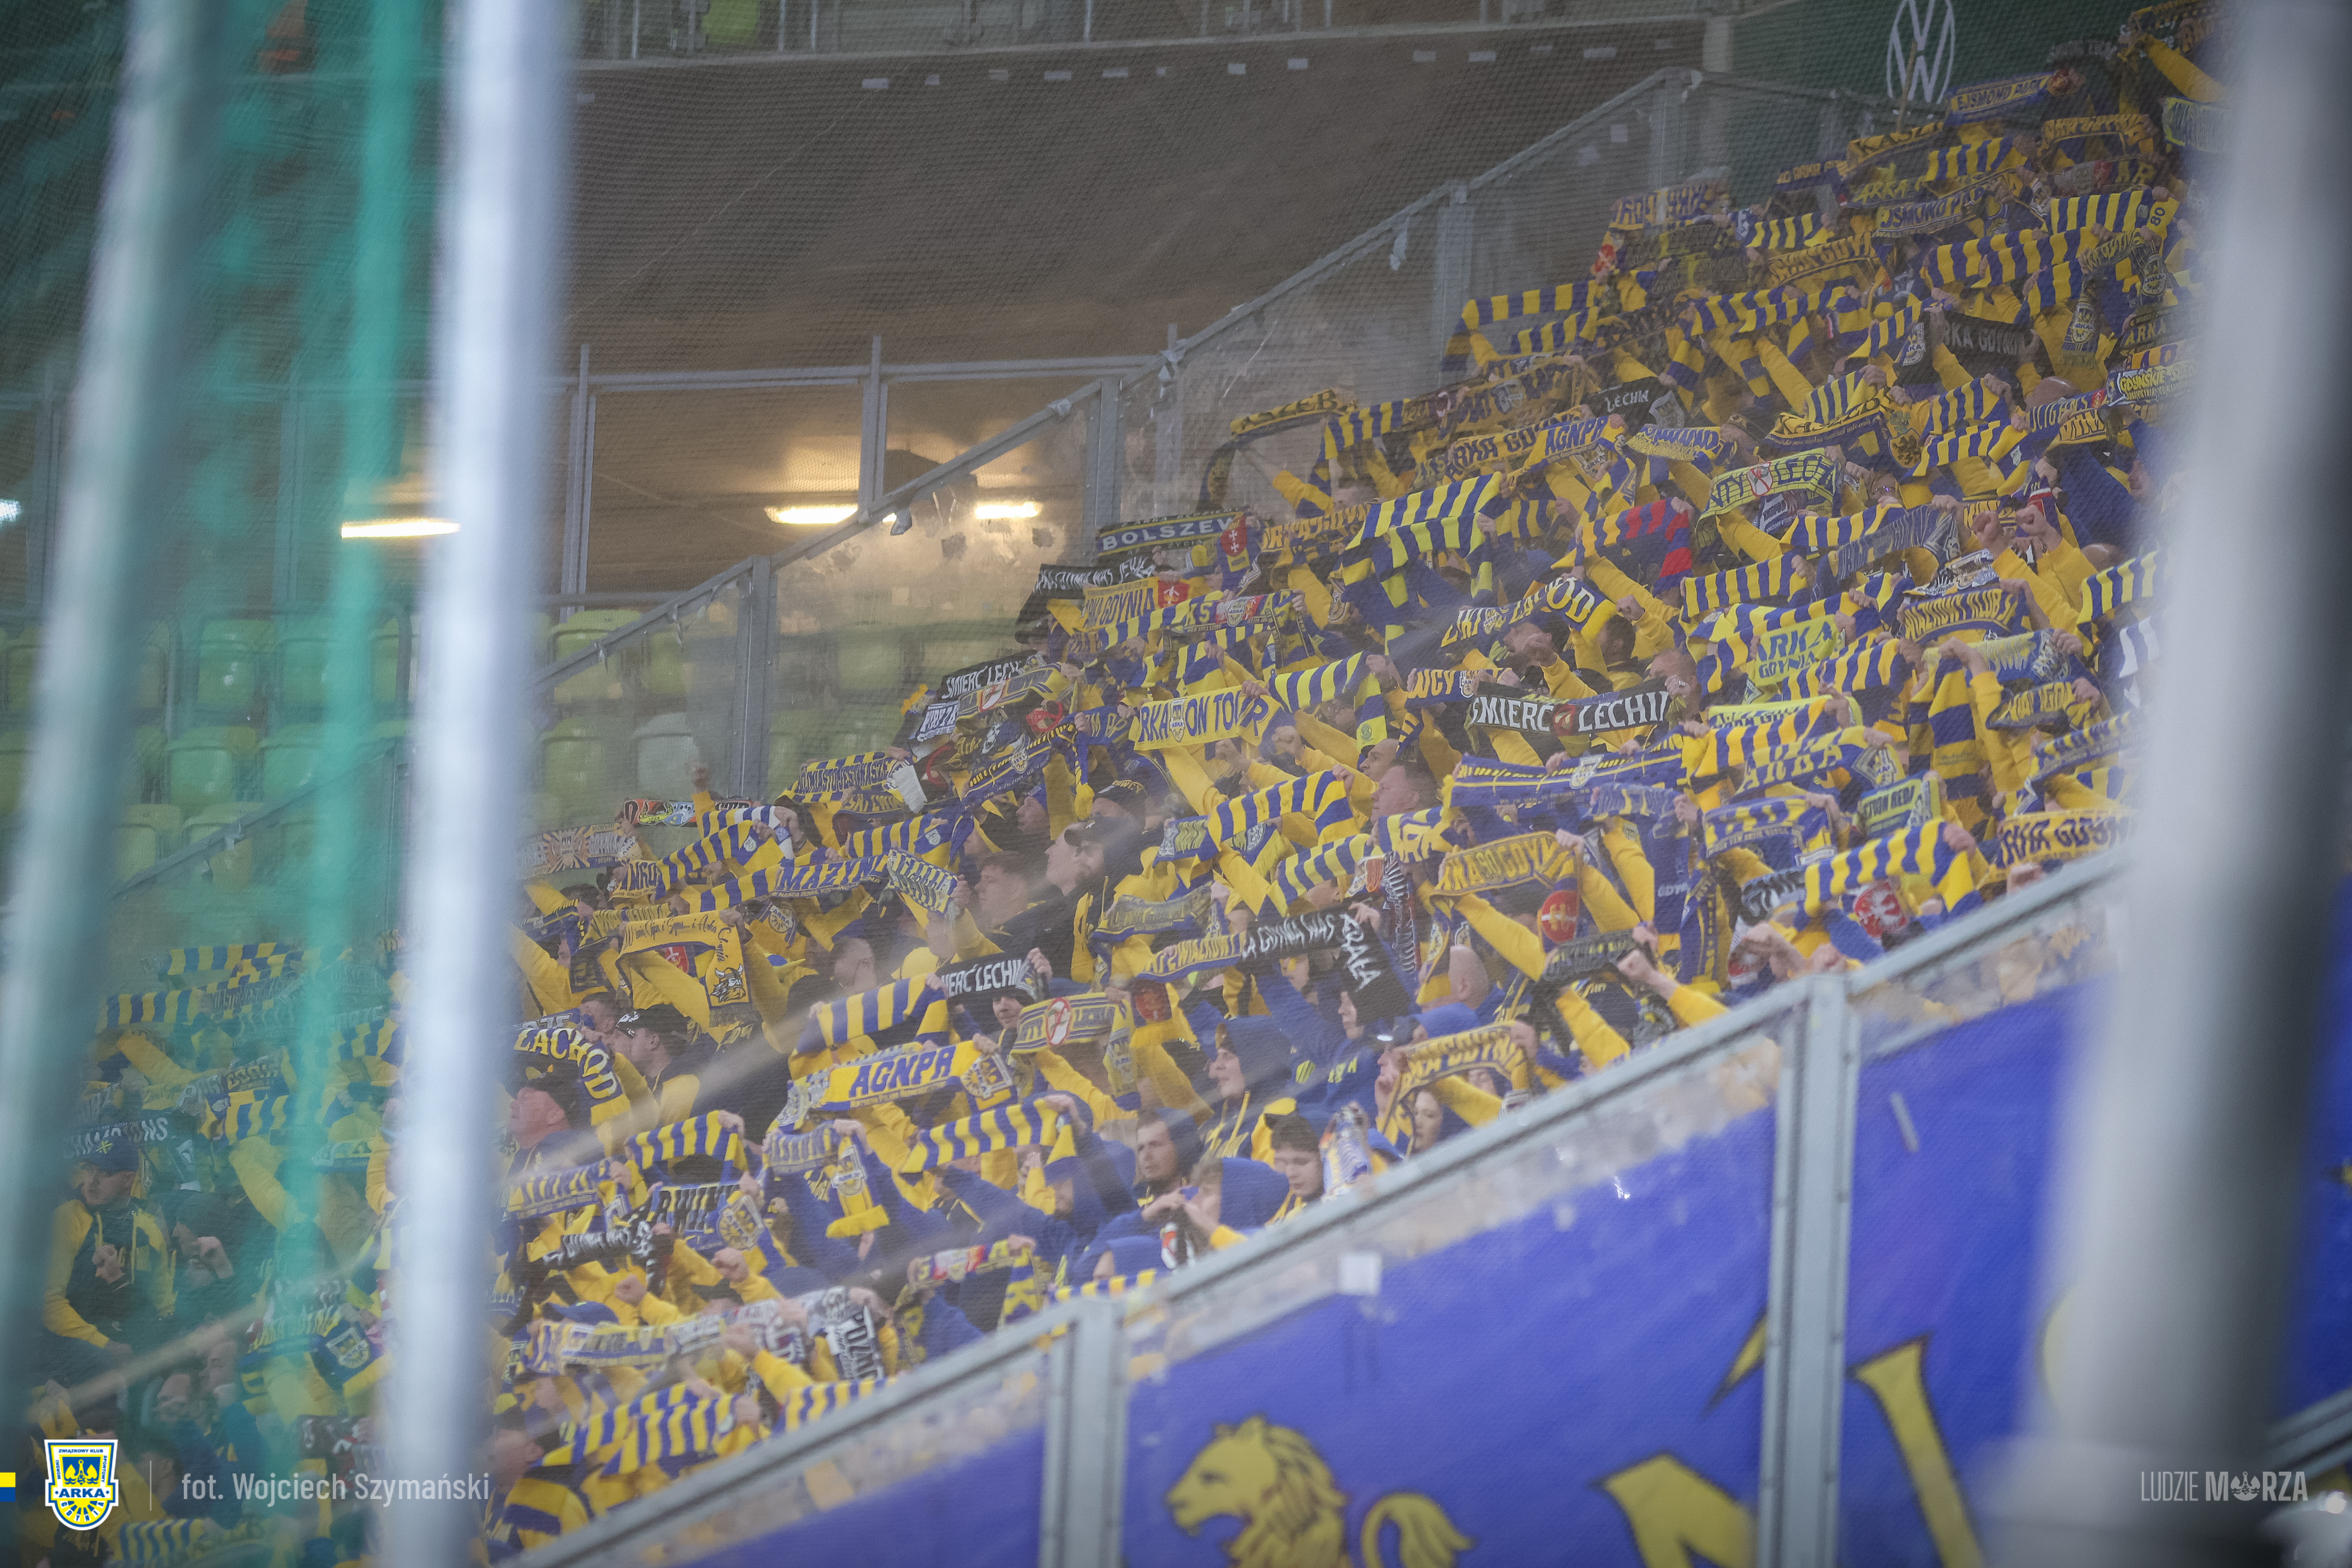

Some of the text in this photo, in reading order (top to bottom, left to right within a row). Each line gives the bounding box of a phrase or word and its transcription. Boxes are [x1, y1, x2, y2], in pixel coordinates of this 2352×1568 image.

[1956, 86, 2011, 112] EJSMOND
[2149, 206, 2166, 235] 80
[1137, 704, 1168, 744] RKA
[1182, 697, 1208, 738] ON
